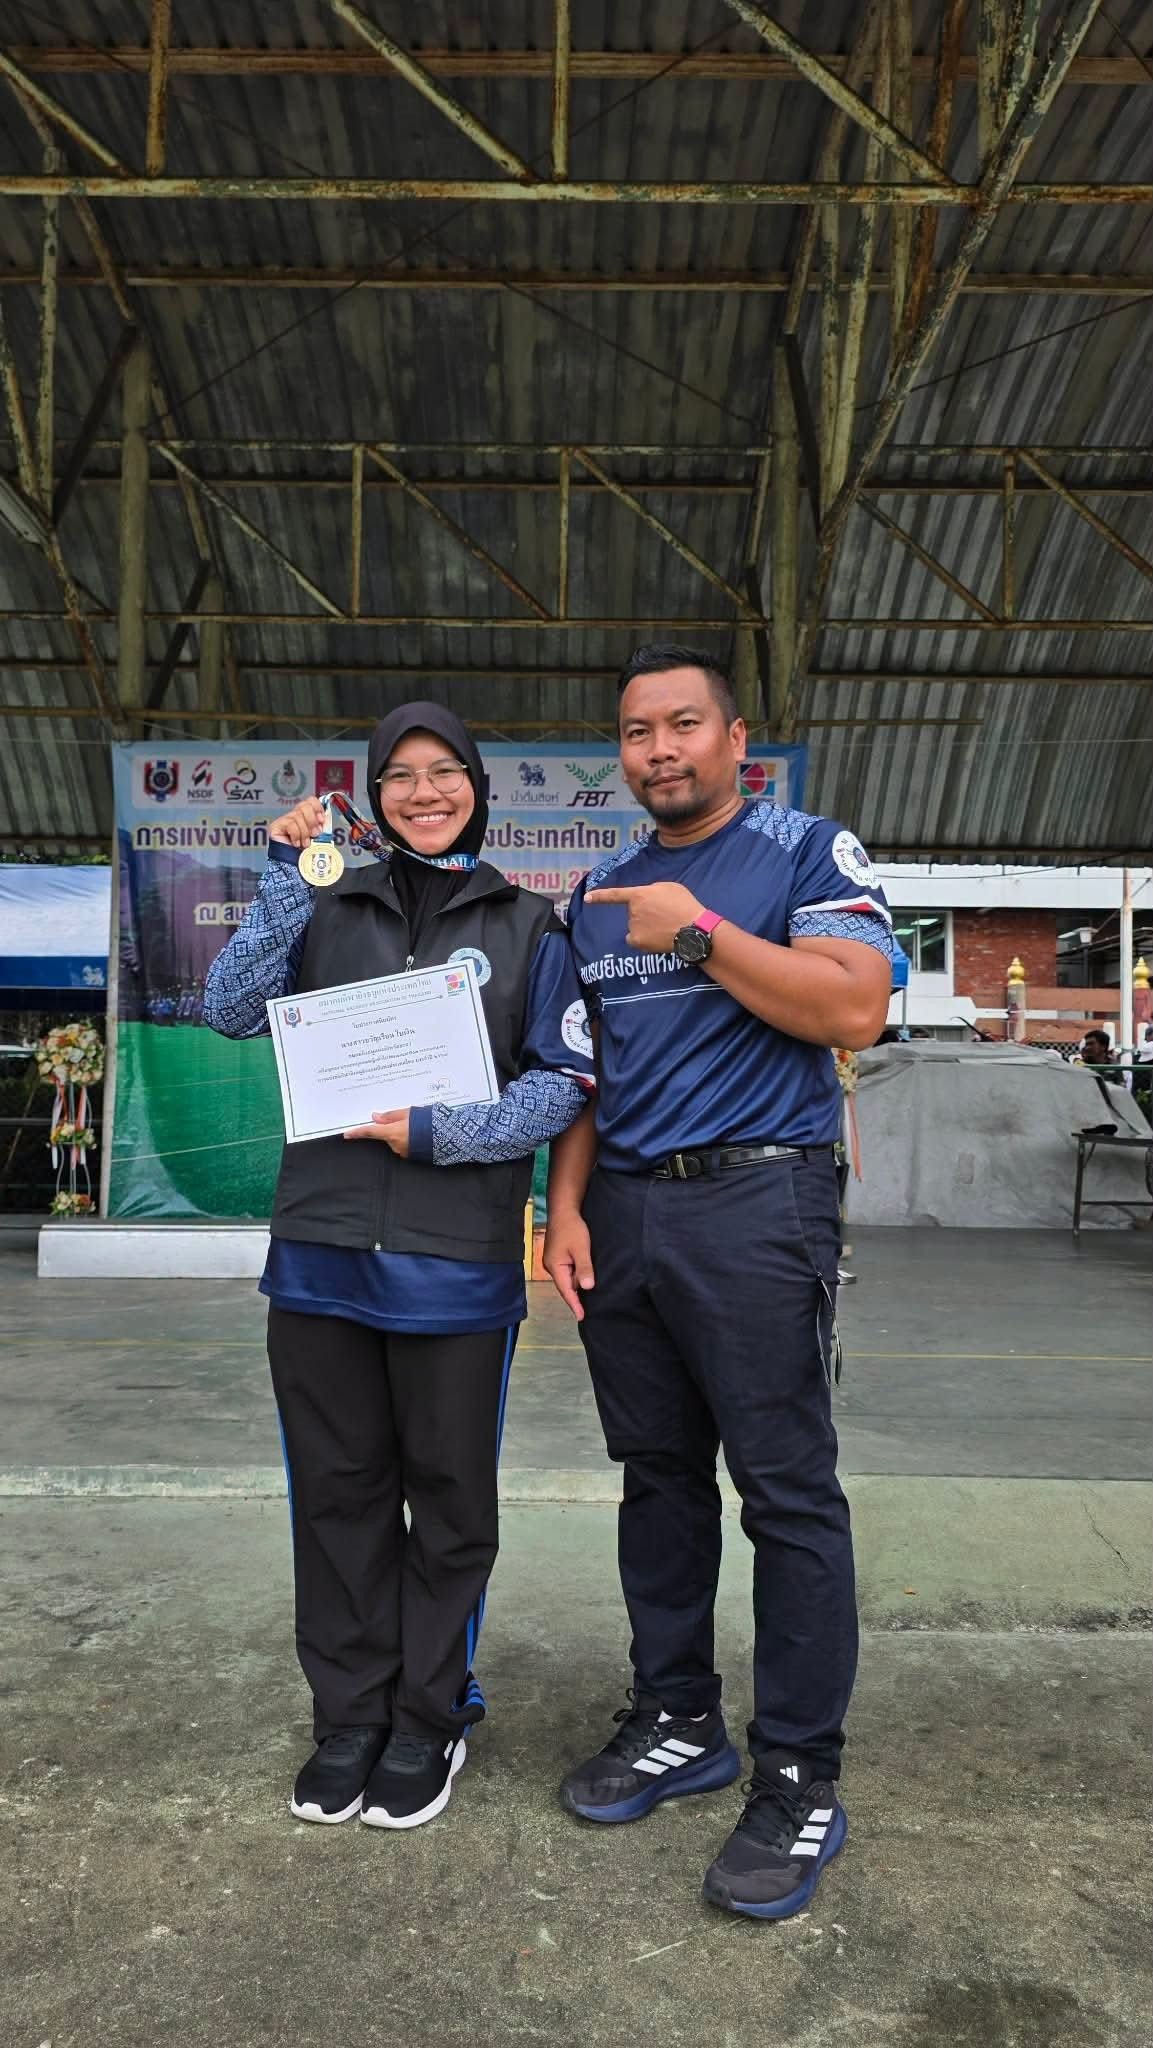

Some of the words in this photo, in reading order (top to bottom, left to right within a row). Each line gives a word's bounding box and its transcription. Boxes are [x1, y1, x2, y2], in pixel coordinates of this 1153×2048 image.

[187, 789, 215, 798] NSDF
[227, 789, 265, 800] SAT
[566, 790, 616, 807] FBT
